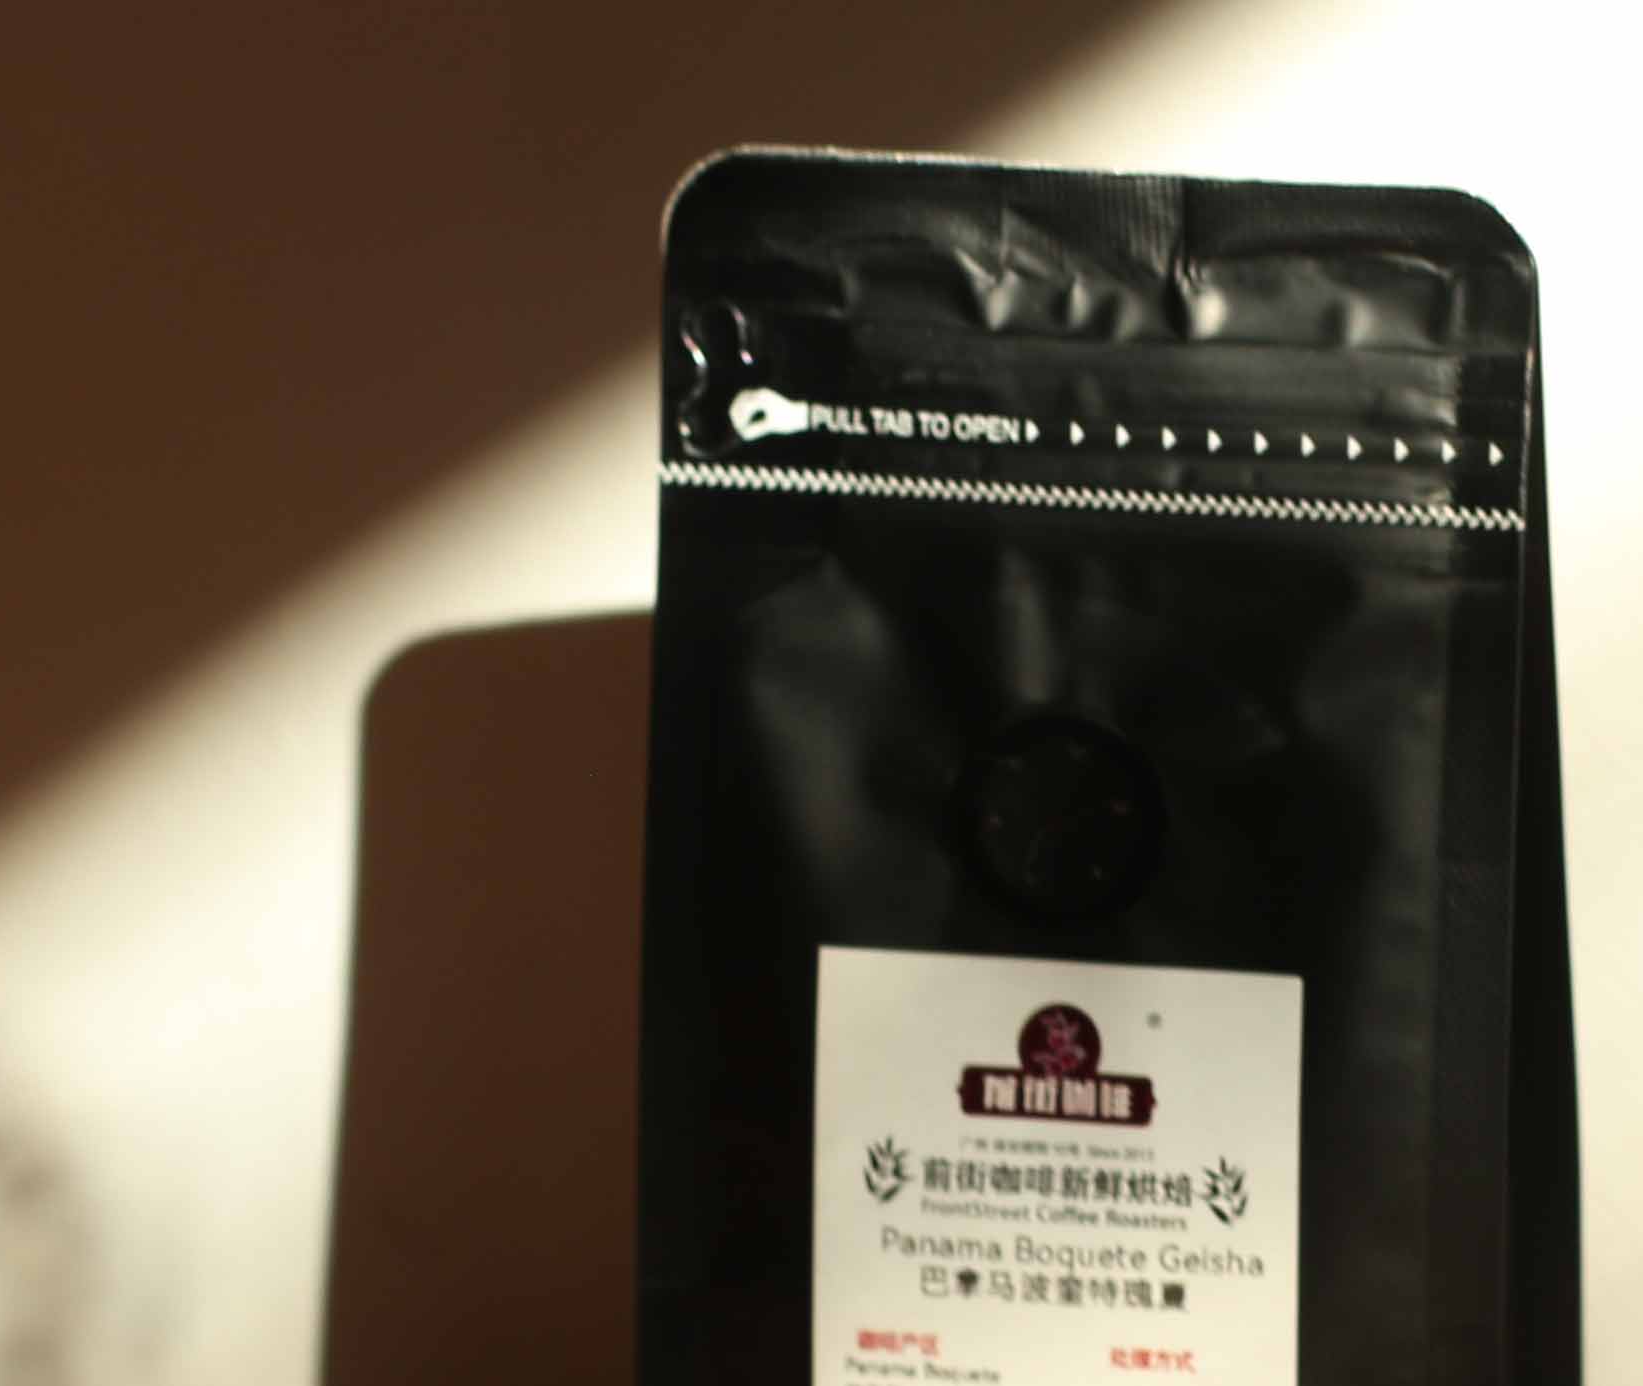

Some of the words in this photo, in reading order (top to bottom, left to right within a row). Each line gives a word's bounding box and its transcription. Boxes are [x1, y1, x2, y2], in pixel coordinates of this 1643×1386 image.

[810, 403, 868, 434] PULL
[871, 406, 914, 437] TAB
[918, 411, 950, 440] TO
[954, 412, 1019, 443] OPEN
[923, 1156, 1193, 1208] 前街咖啡新鲜烘焙
[921, 1198, 1031, 1222] FrontStreet
[1035, 1206, 1099, 1226] Coffee
[1105, 1209, 1189, 1231] Roasters
[881, 1226, 1001, 1262] Panama
[1015, 1234, 1147, 1276] Boquete
[1157, 1243, 1264, 1278] Geisha
